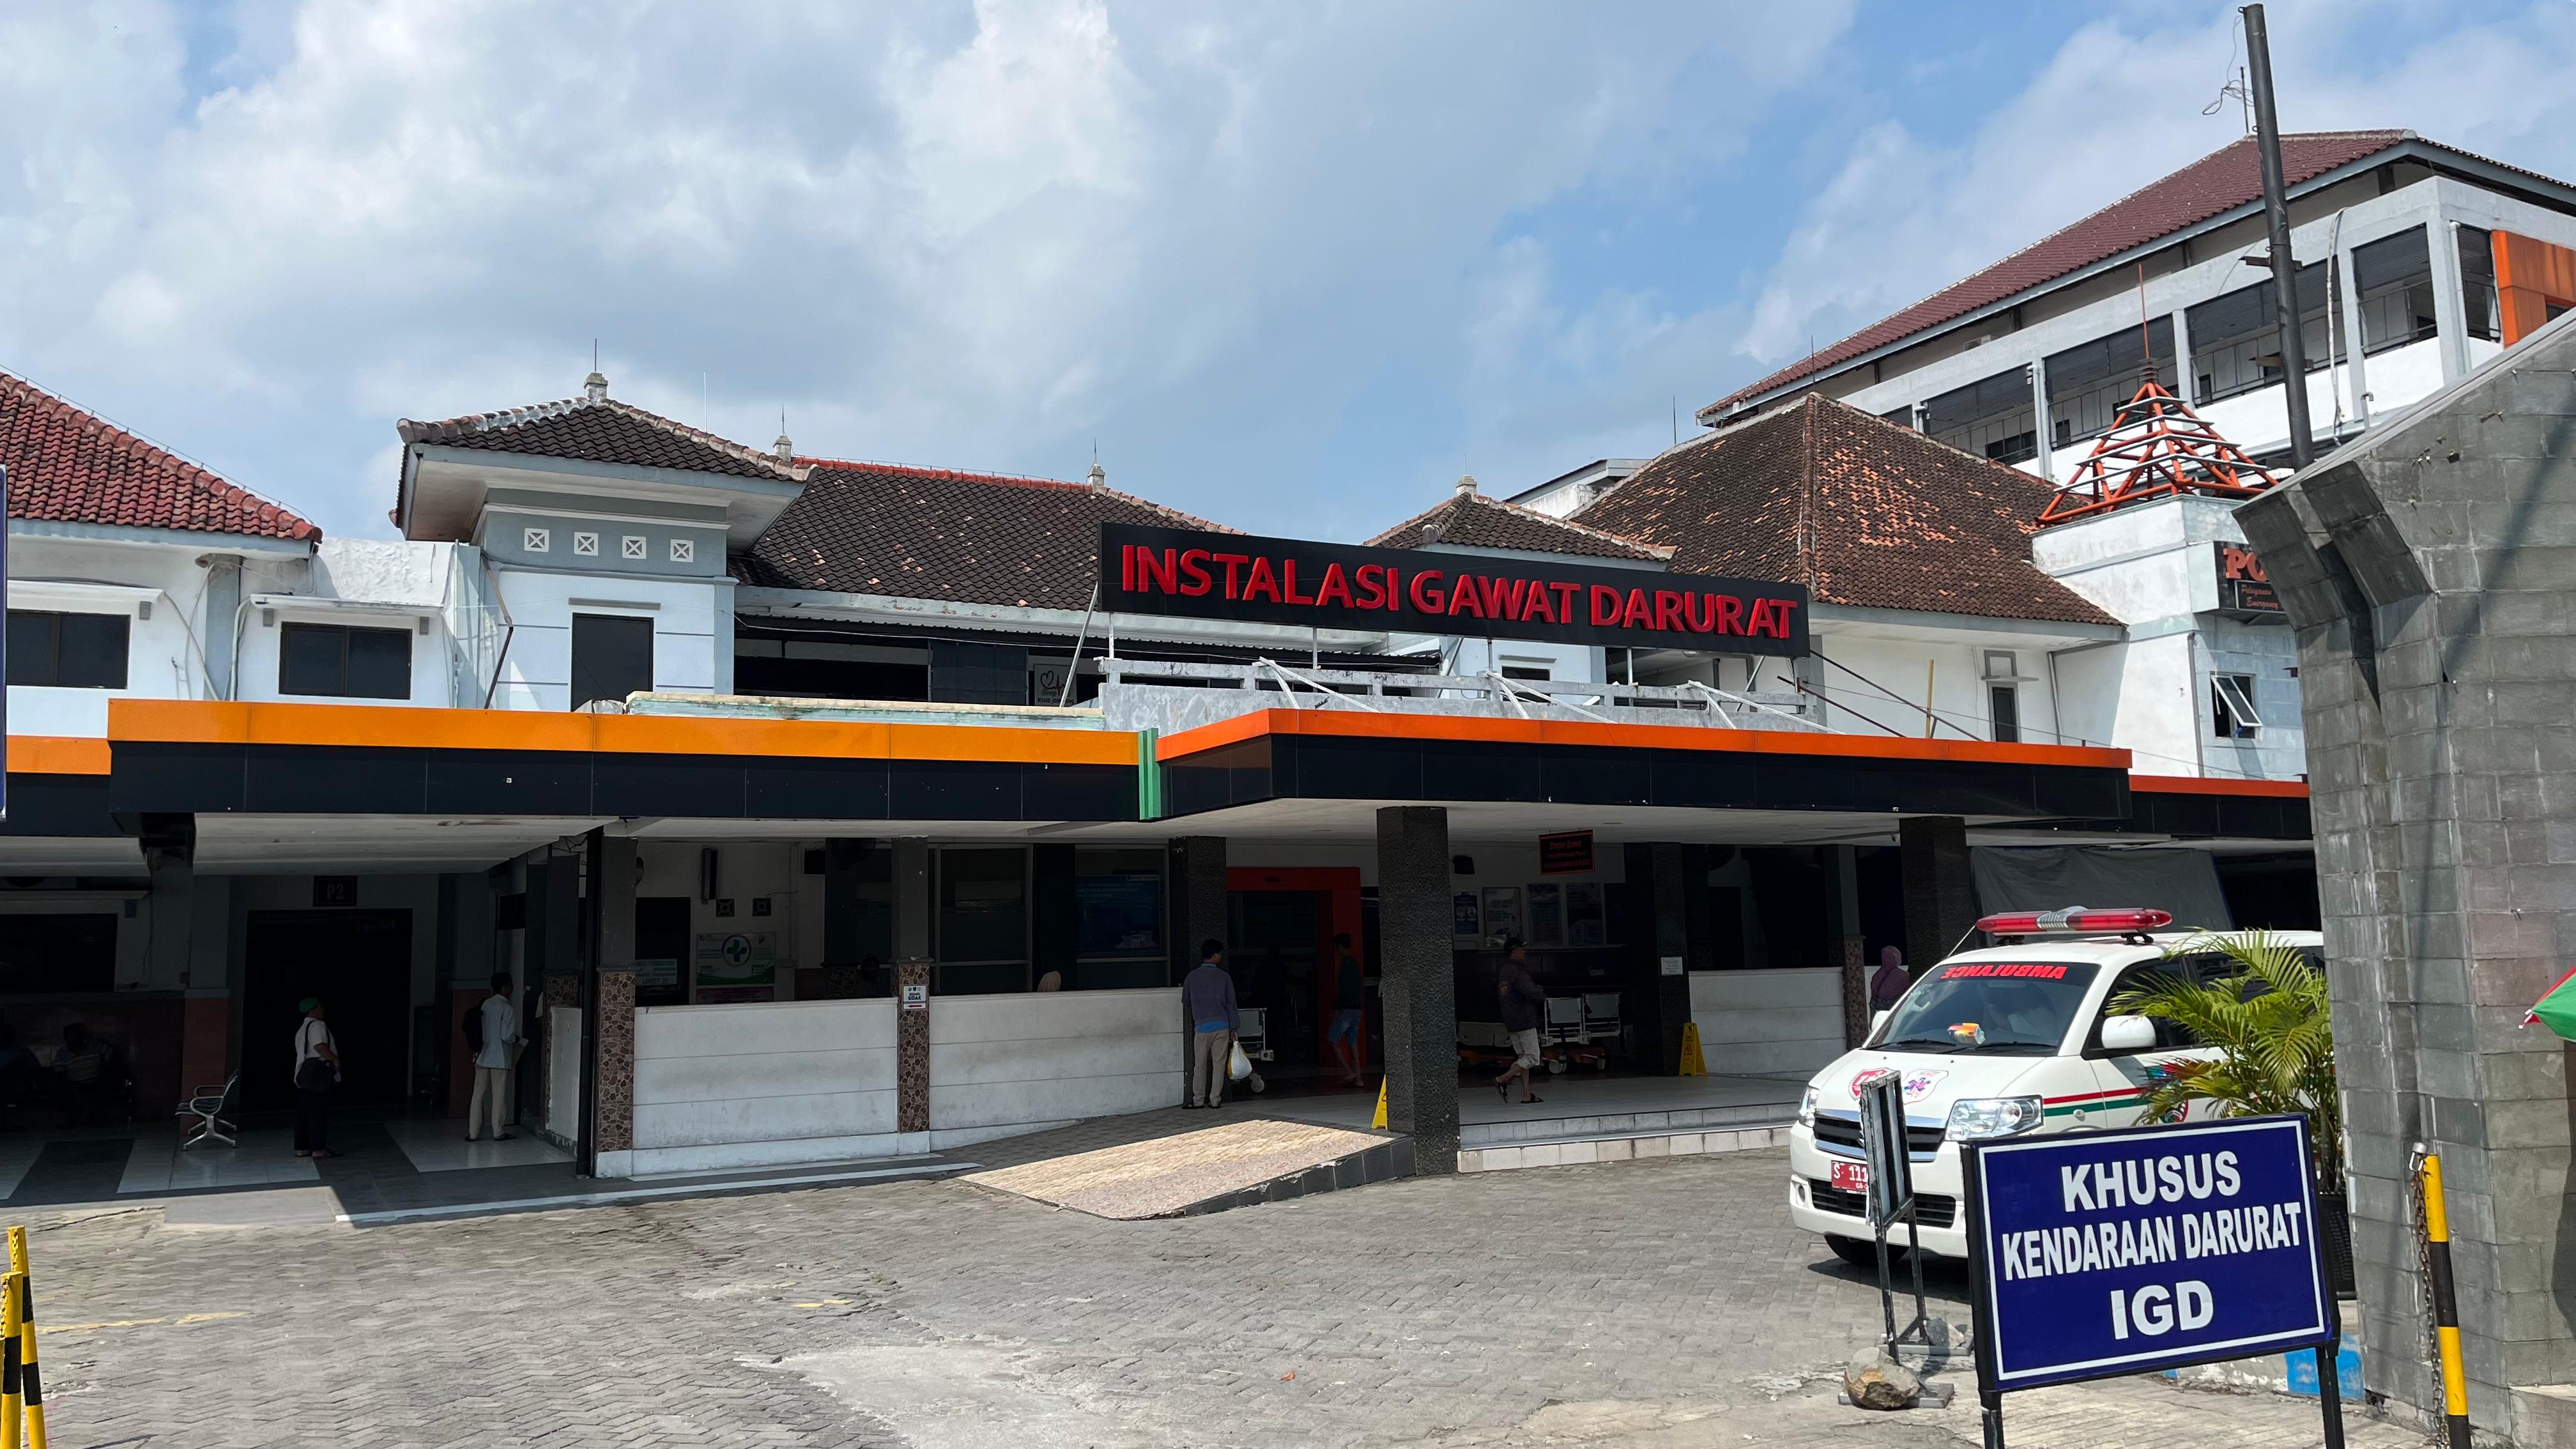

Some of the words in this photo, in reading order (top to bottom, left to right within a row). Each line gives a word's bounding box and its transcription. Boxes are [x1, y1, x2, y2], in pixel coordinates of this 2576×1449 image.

[1122, 544, 1399, 611] INSTALASI
[1411, 570, 1581, 624] GAWAT
[1590, 585, 1798, 640] DARURAT
[326, 884, 344, 900] P2
[2061, 1150, 2241, 1212] KHUSUS
[2002, 1215, 2177, 1280] KENDARAAN
[2182, 1201, 2301, 1259] DARURAT
[2110, 1280, 2214, 1340] IGD
